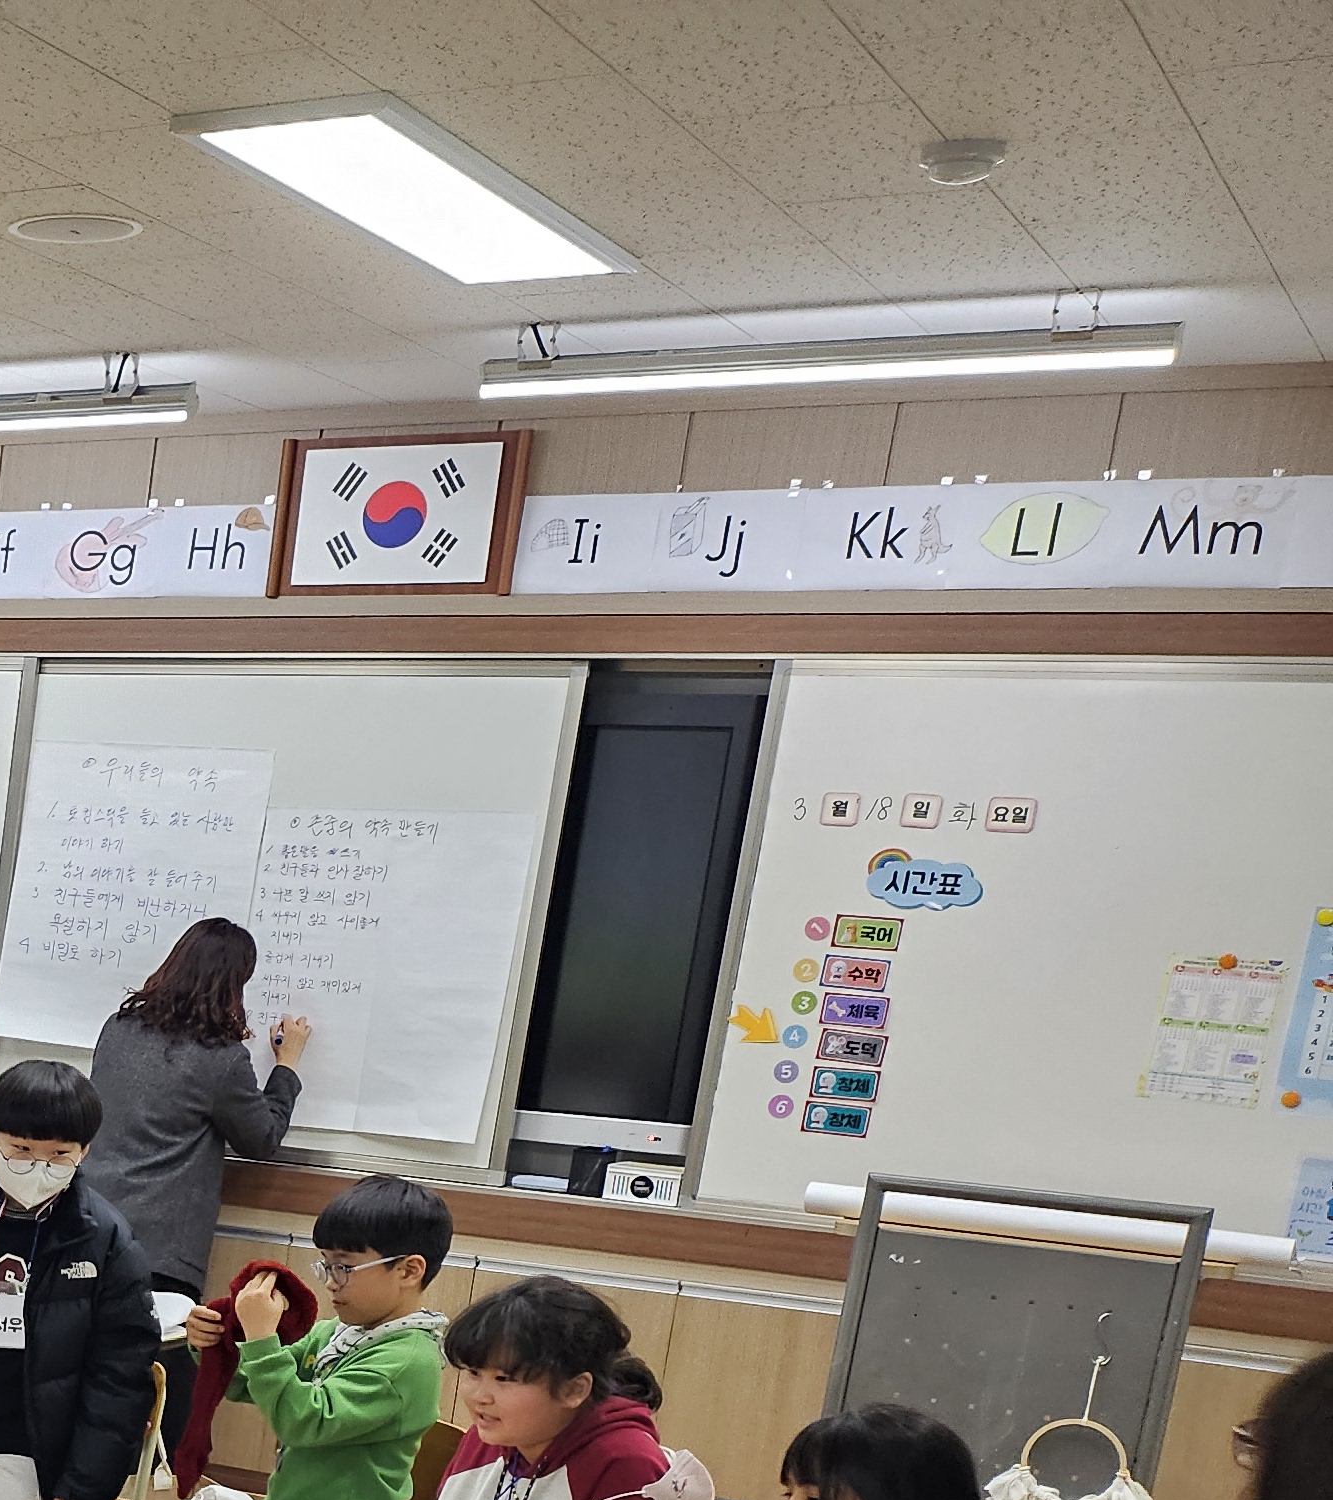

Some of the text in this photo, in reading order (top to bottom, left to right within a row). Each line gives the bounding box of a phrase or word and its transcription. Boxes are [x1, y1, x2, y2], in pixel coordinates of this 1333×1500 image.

[567, 502, 1264, 577] Ii Jj Kk Ll Mm
[70, 530, 137, 586] Gg
[187, 524, 245, 570] Hh
[100, 757, 219, 792] 우리들의 약속
[793, 797, 807, 821] 3
[831, 799, 849, 818] 월
[912, 800, 931, 819] 일
[948, 801, 978, 831] 화
[992, 805, 1030, 825] 요일
[307, 814, 439, 844] 존중의 약속 만들기
[61, 835, 94, 851] 이야기
[280, 863, 320, 879] 친구들과
[884, 869, 964, 896] 시간표
[54, 887, 124, 911] 친구들에게
[136, 896, 208, 919] 비난하거나
[270, 929, 303, 945] 지내기
[810, 922, 894, 943] 1 국어
[43, 940, 80, 962] 비밀로
[90, 947, 123, 968] 하기
[300, 953, 334, 969] 지내기
[800, 963, 882, 984] 2 수학
[798, 996, 881, 1021] 3 체육
[788, 1029, 878, 1058] 4 도덕
[781, 1065, 792, 1079] 5
[775, 1101, 788, 1114] 6
